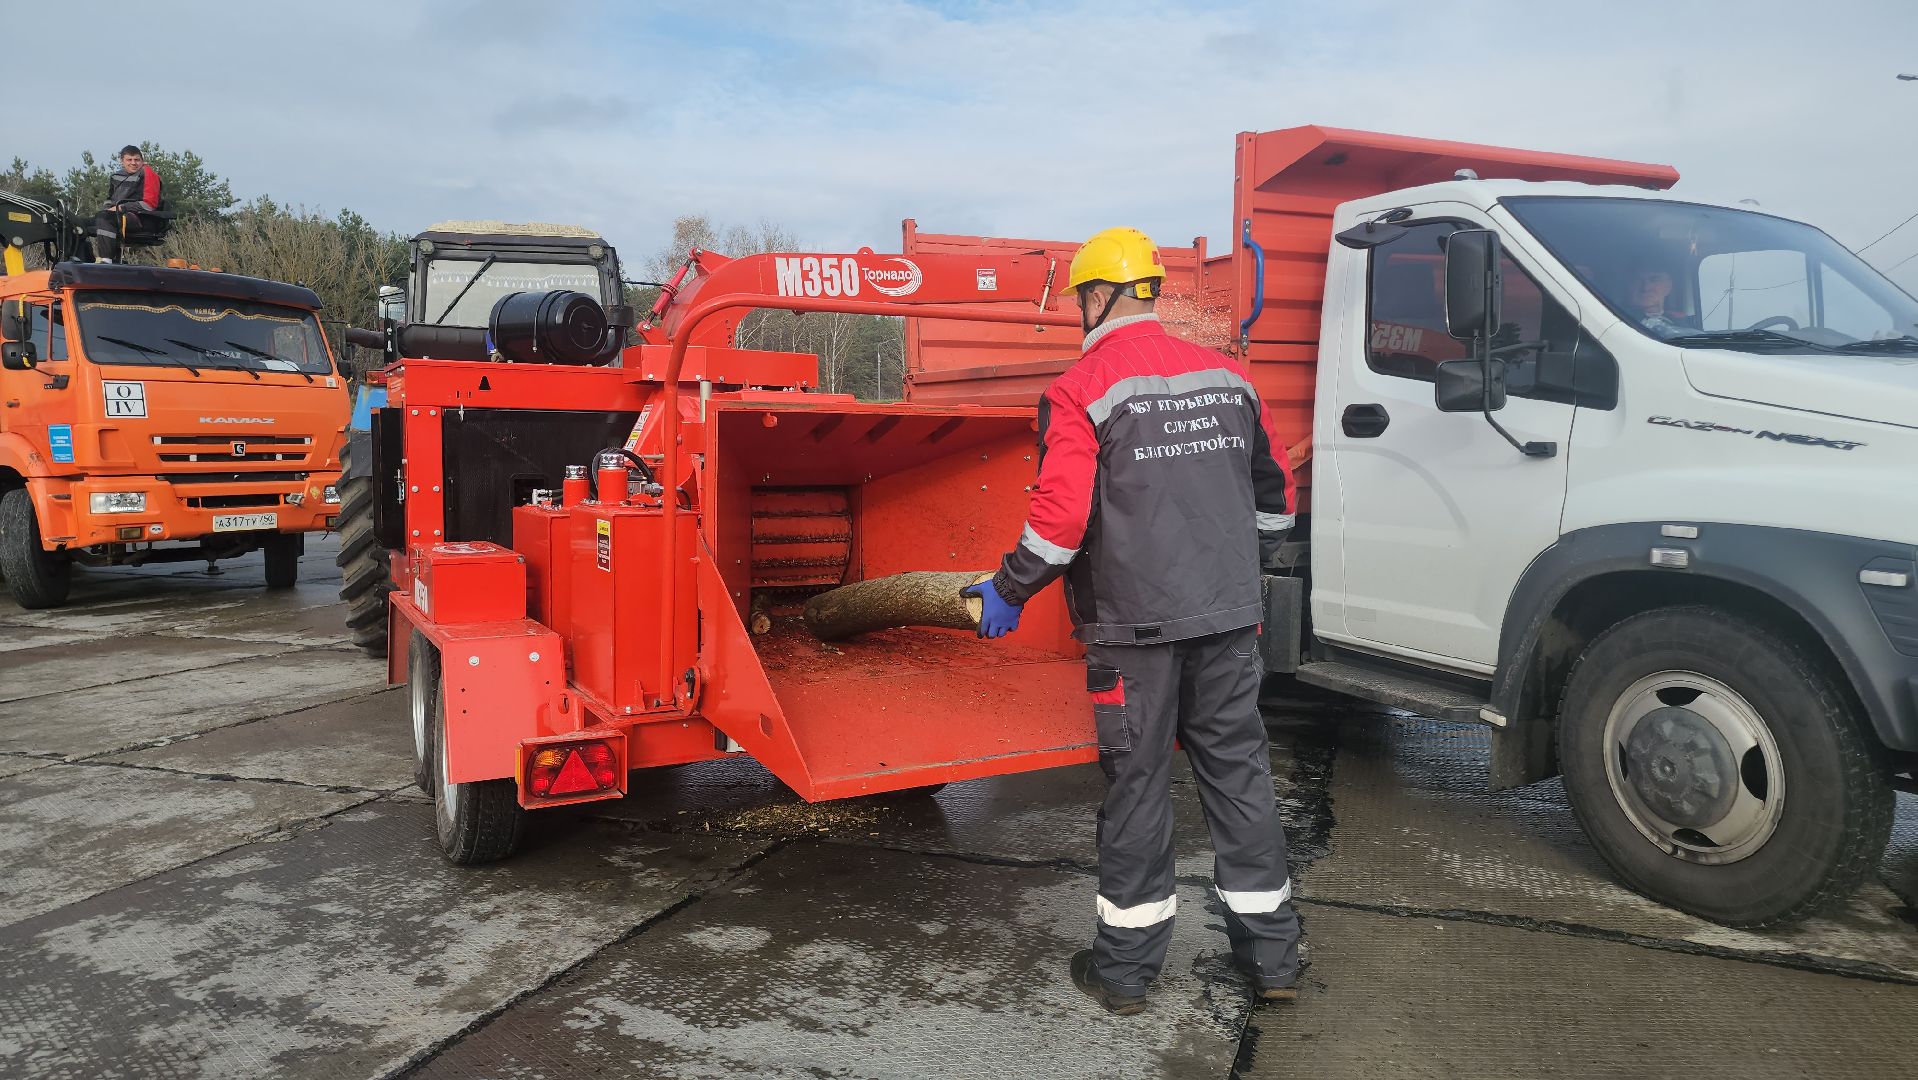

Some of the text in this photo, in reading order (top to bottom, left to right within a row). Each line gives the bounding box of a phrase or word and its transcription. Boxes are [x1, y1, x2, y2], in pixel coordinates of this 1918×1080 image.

[862, 267, 913, 282] Торнадо
[116, 401, 136, 414] IV
[1127, 400, 1152, 415] МБУ
[1164, 415, 1219, 434] СЛУЖБА
[1755, 430, 1868, 451] NEXT
